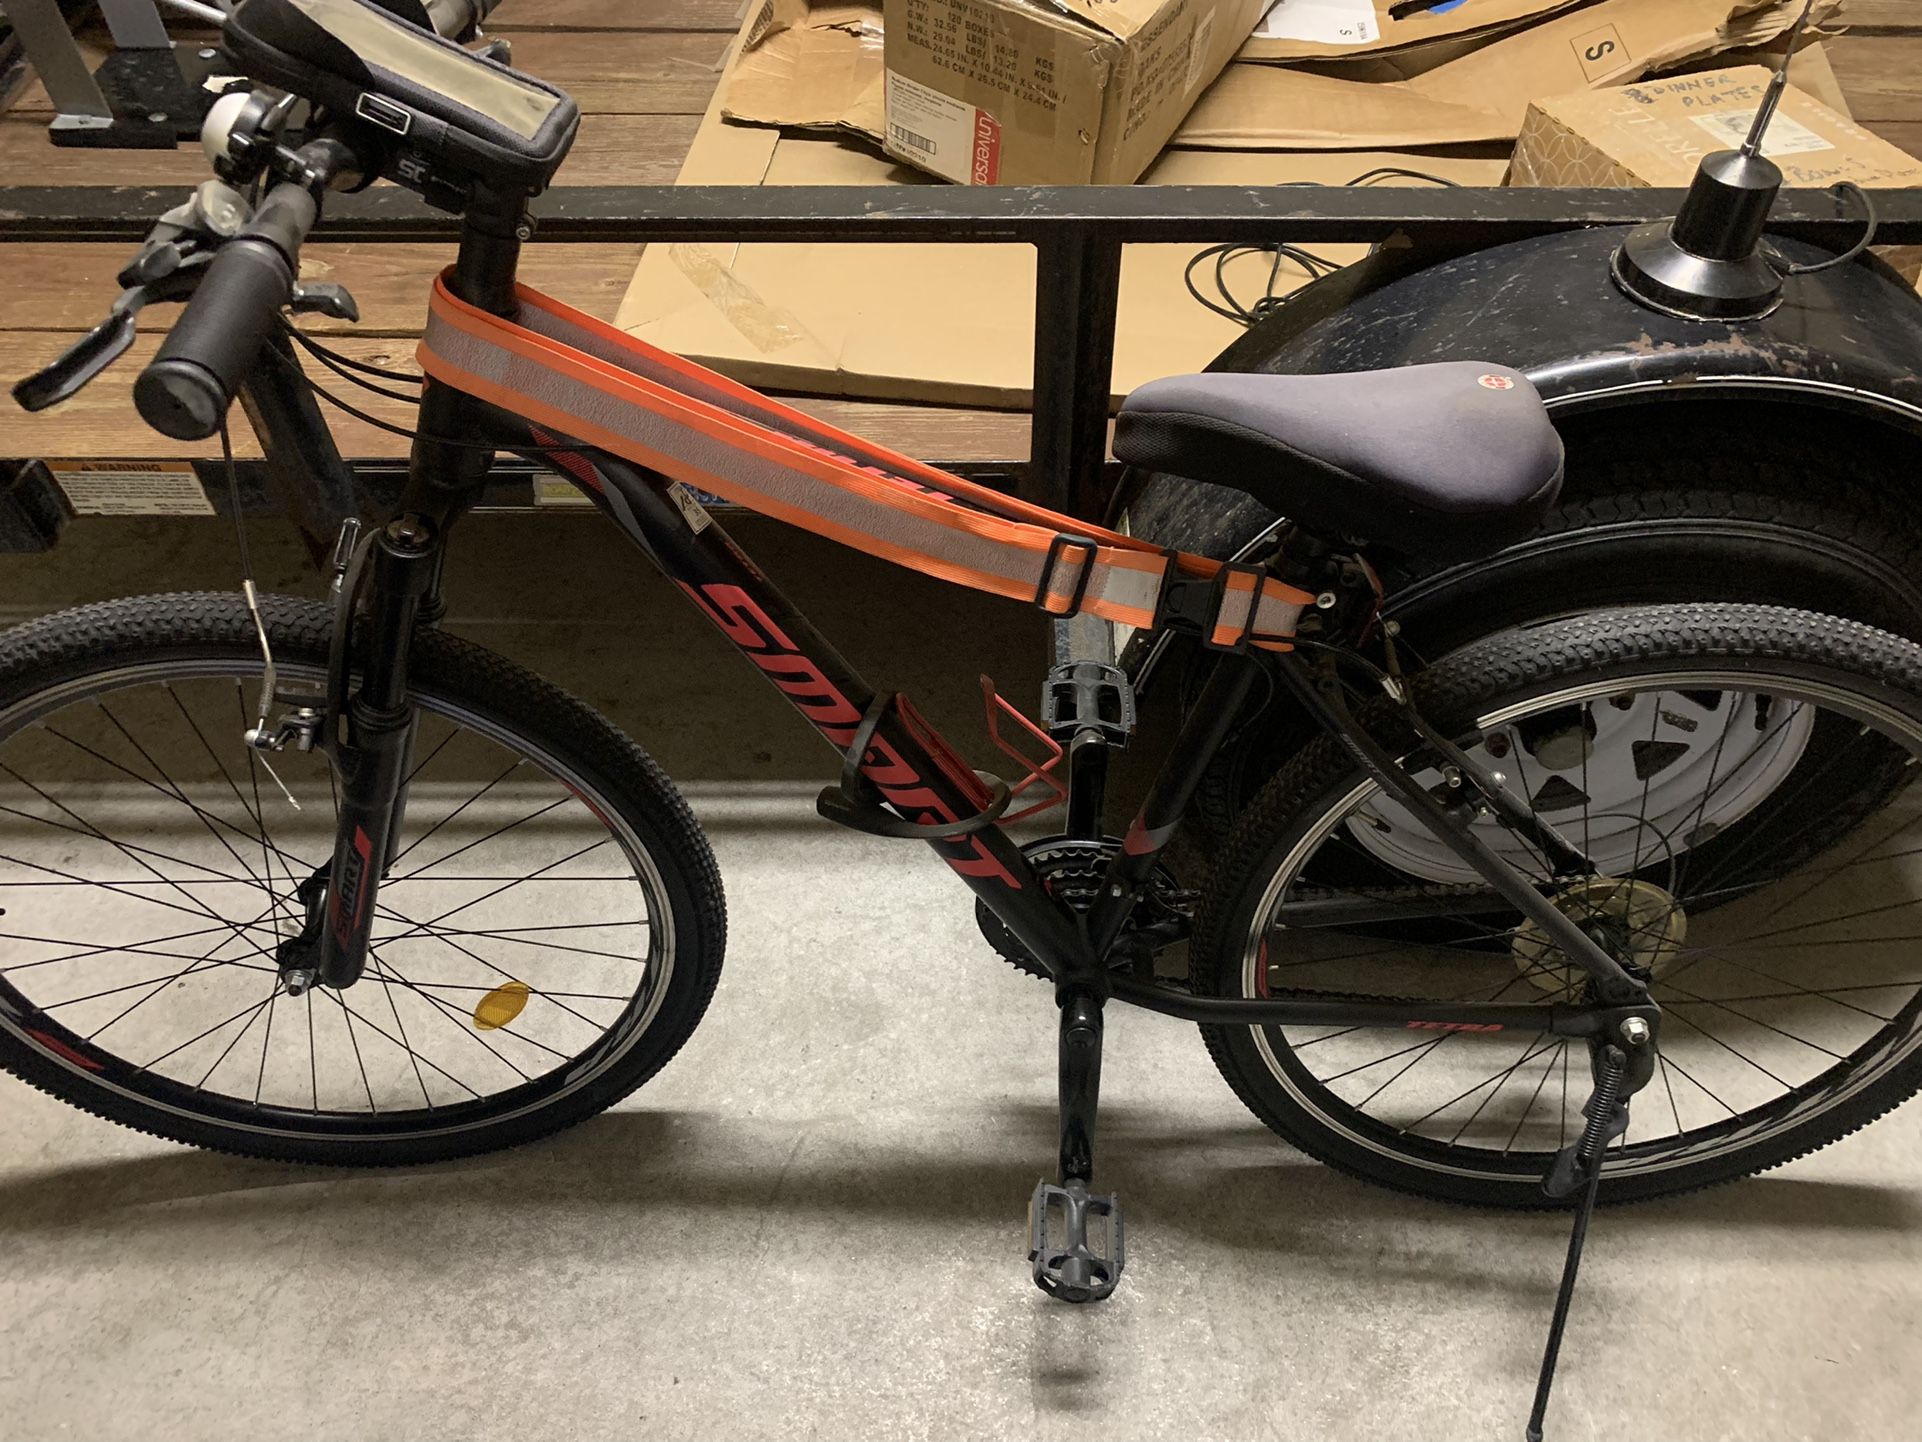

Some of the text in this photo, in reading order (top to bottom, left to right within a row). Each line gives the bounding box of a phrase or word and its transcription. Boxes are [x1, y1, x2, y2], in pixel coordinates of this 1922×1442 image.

[1585, 40, 1615, 61] S
[1034, 56, 1055, 71] KGS
[1034, 69, 1055, 84] KGS
[997, 81, 1011, 94] CM
[1650, 73, 1737, 96] DINNER
[976, 116, 996, 186] universa
[95, 463, 162, 472] WARNING
